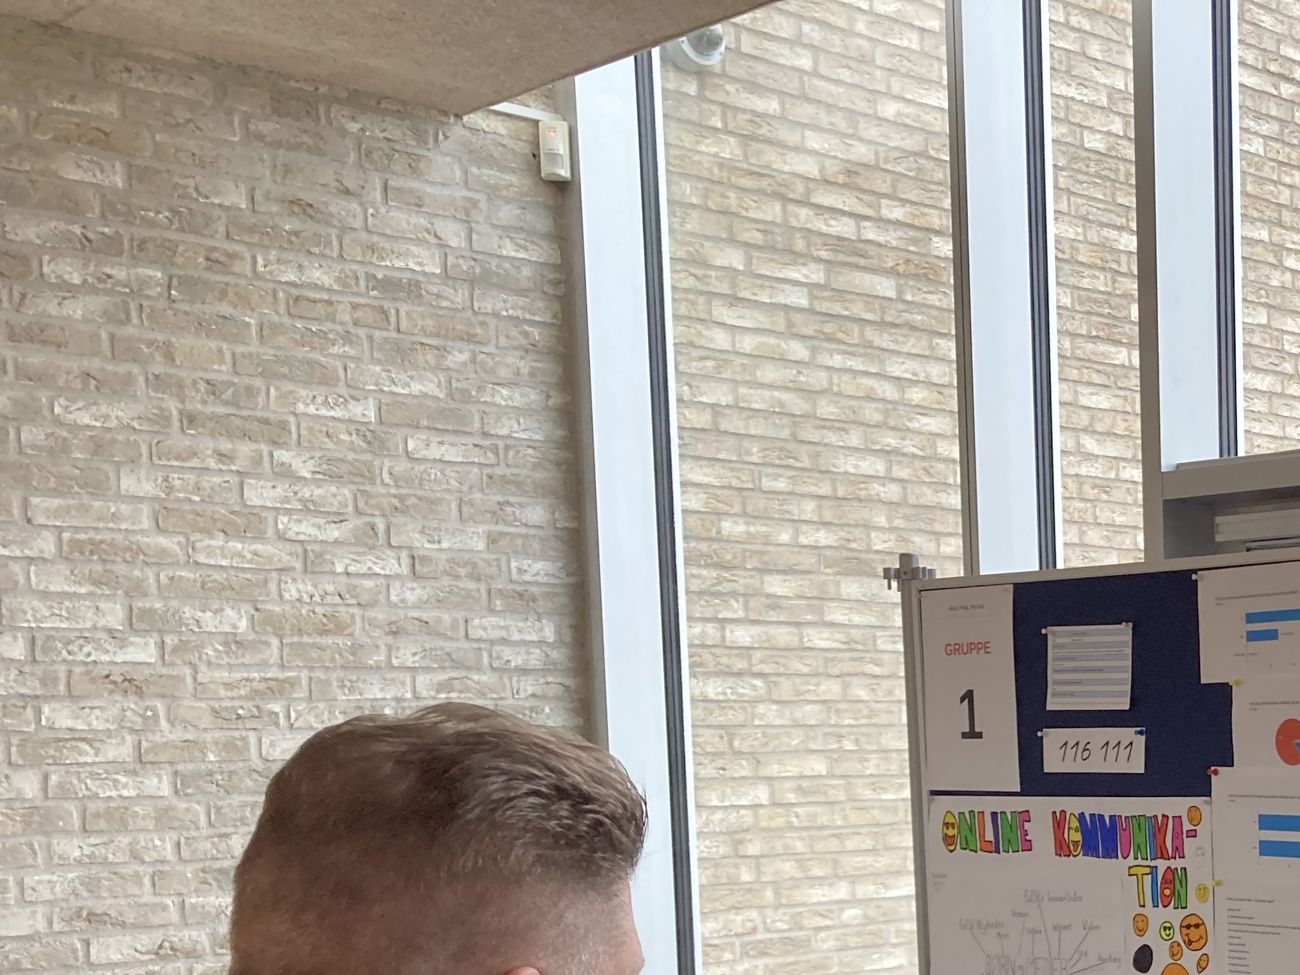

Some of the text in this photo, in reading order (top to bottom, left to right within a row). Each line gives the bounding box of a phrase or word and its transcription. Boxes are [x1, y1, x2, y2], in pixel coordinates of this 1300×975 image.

[944, 641, 991, 657] GRUPPE
[959, 688, 983, 739] 1
[1059, 740, 1134, 764] 116 111
[941, 809, 1032, 855] ONLINE
[1127, 864, 1188, 910] TION
